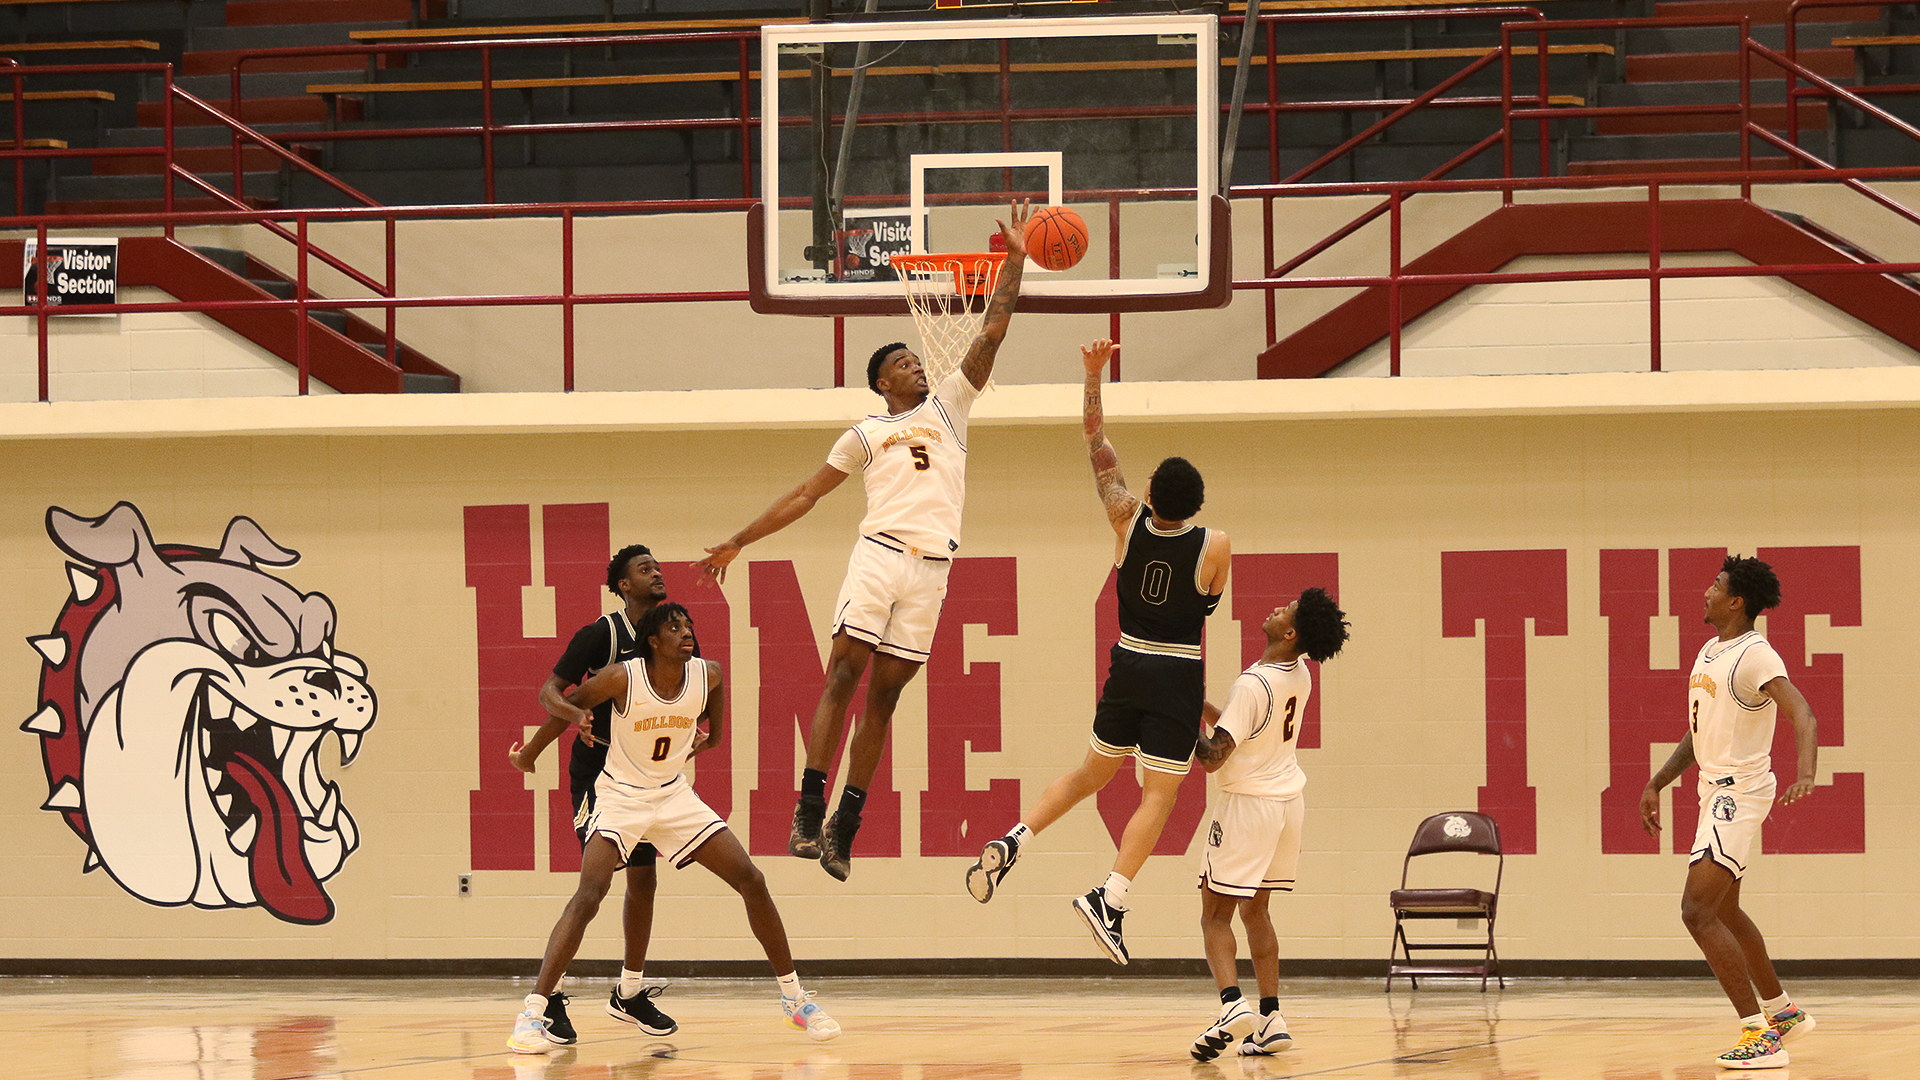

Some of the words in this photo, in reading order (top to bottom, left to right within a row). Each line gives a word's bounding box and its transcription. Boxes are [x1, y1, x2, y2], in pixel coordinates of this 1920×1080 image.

[873, 221, 912, 242] Visito
[63, 249, 111, 270] Visitor
[57, 272, 114, 294] Section
[909, 445, 930, 471] 5
[1141, 560, 1172, 605] 0
[1441, 545, 1866, 855] THE
[1283, 695, 1297, 743] 2
[651, 736, 671, 763] 0
